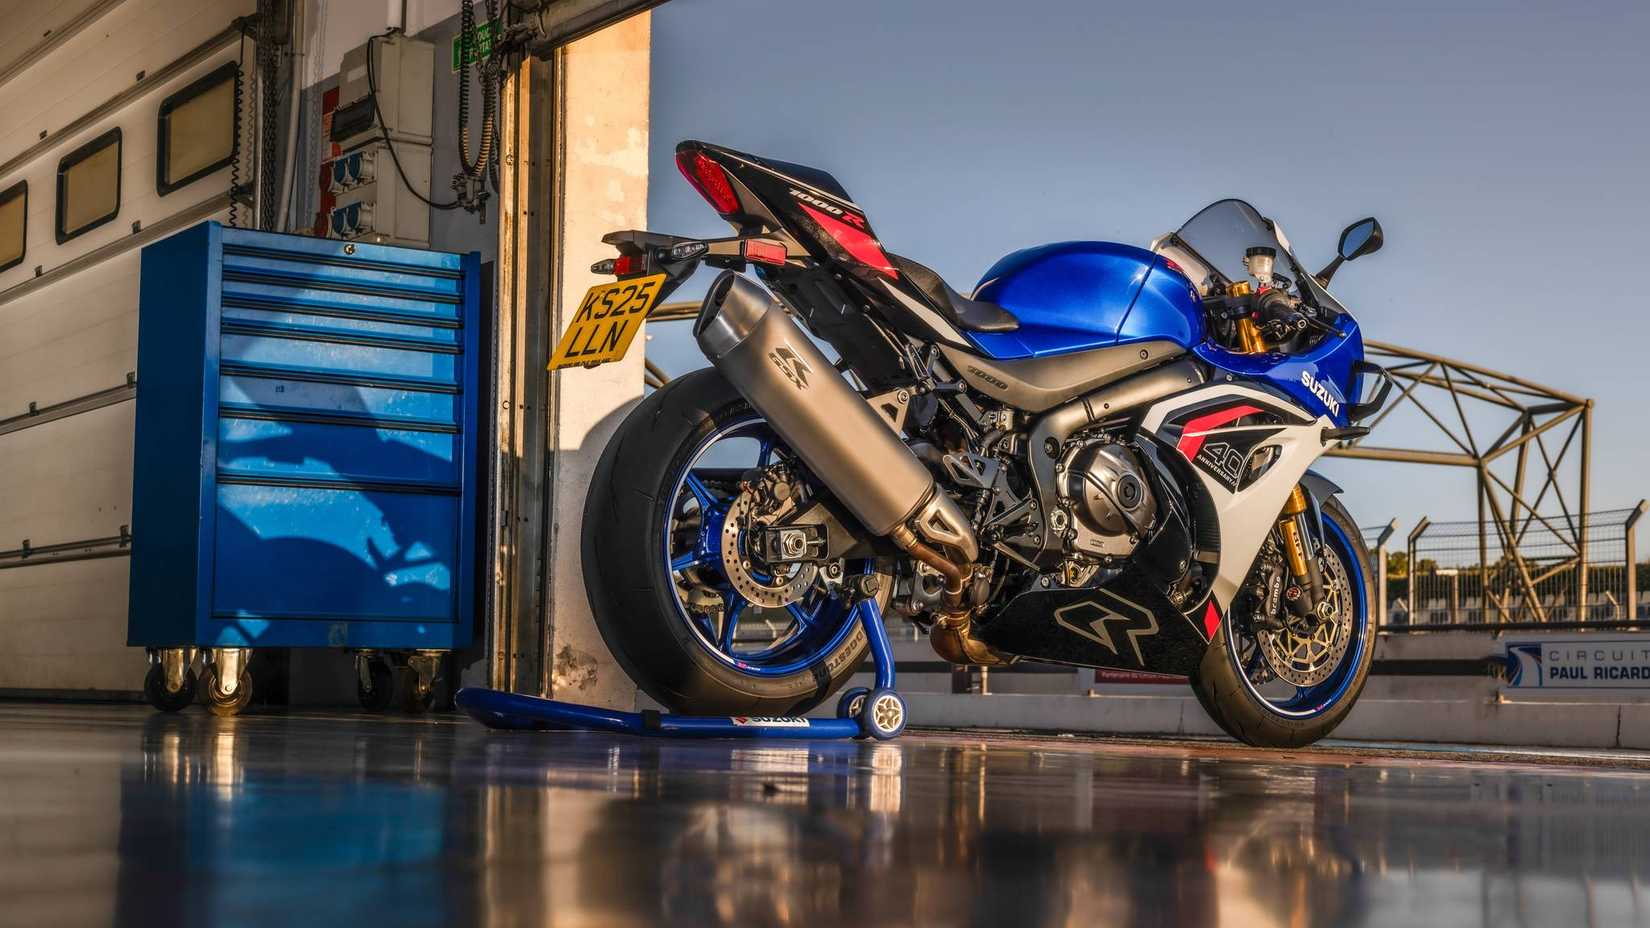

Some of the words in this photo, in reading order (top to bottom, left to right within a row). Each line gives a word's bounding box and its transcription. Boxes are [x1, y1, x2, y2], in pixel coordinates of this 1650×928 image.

[576, 281, 656, 323] KS25
[564, 319, 629, 358] LLN
[1301, 370, 1340, 418] SUZUKI
[1203, 442, 1245, 479] 40
[1270, 576, 1281, 615] brembo
[1549, 650, 1650, 662] CIRCUIT
[1550, 666, 1588, 680] PAUL
[1594, 666, 1650, 680] RICARD
